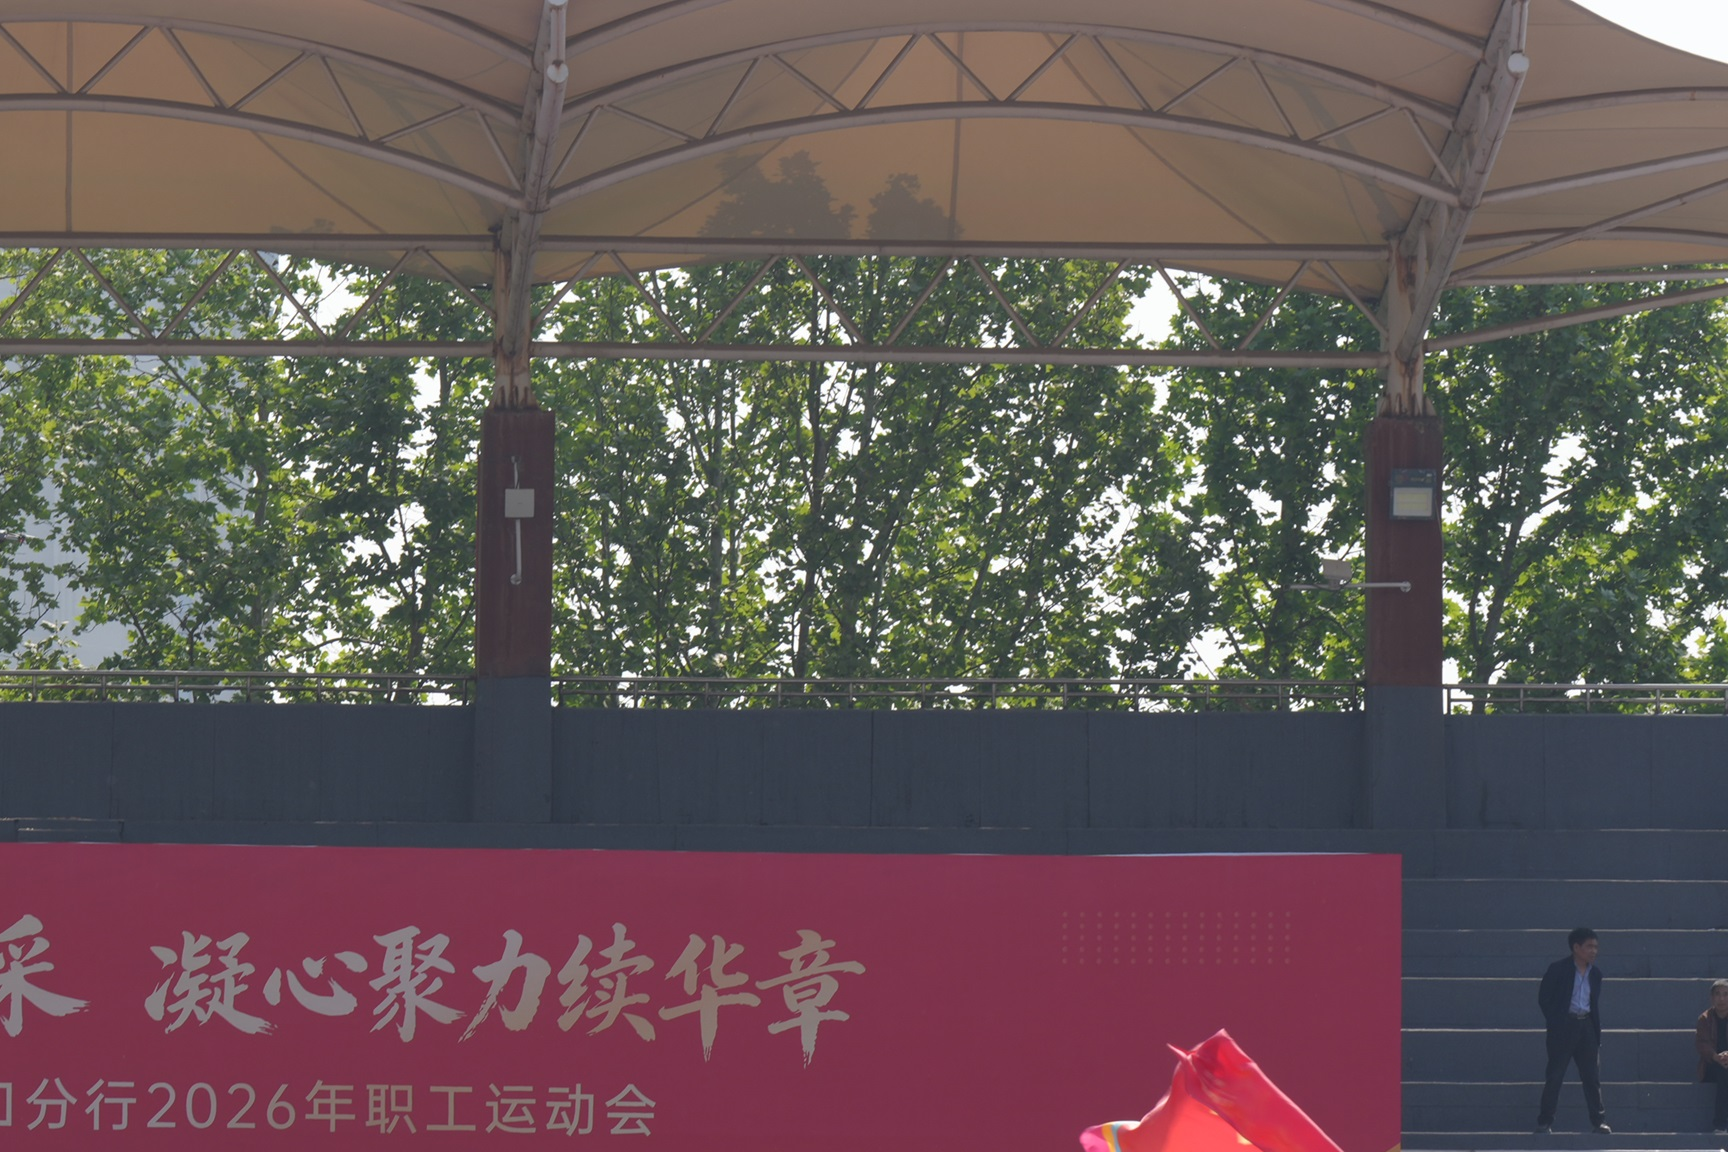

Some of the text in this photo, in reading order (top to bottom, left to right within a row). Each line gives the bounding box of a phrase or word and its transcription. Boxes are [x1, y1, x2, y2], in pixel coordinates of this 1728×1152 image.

[145, 923, 865, 1068] 凝心聚力续华章
